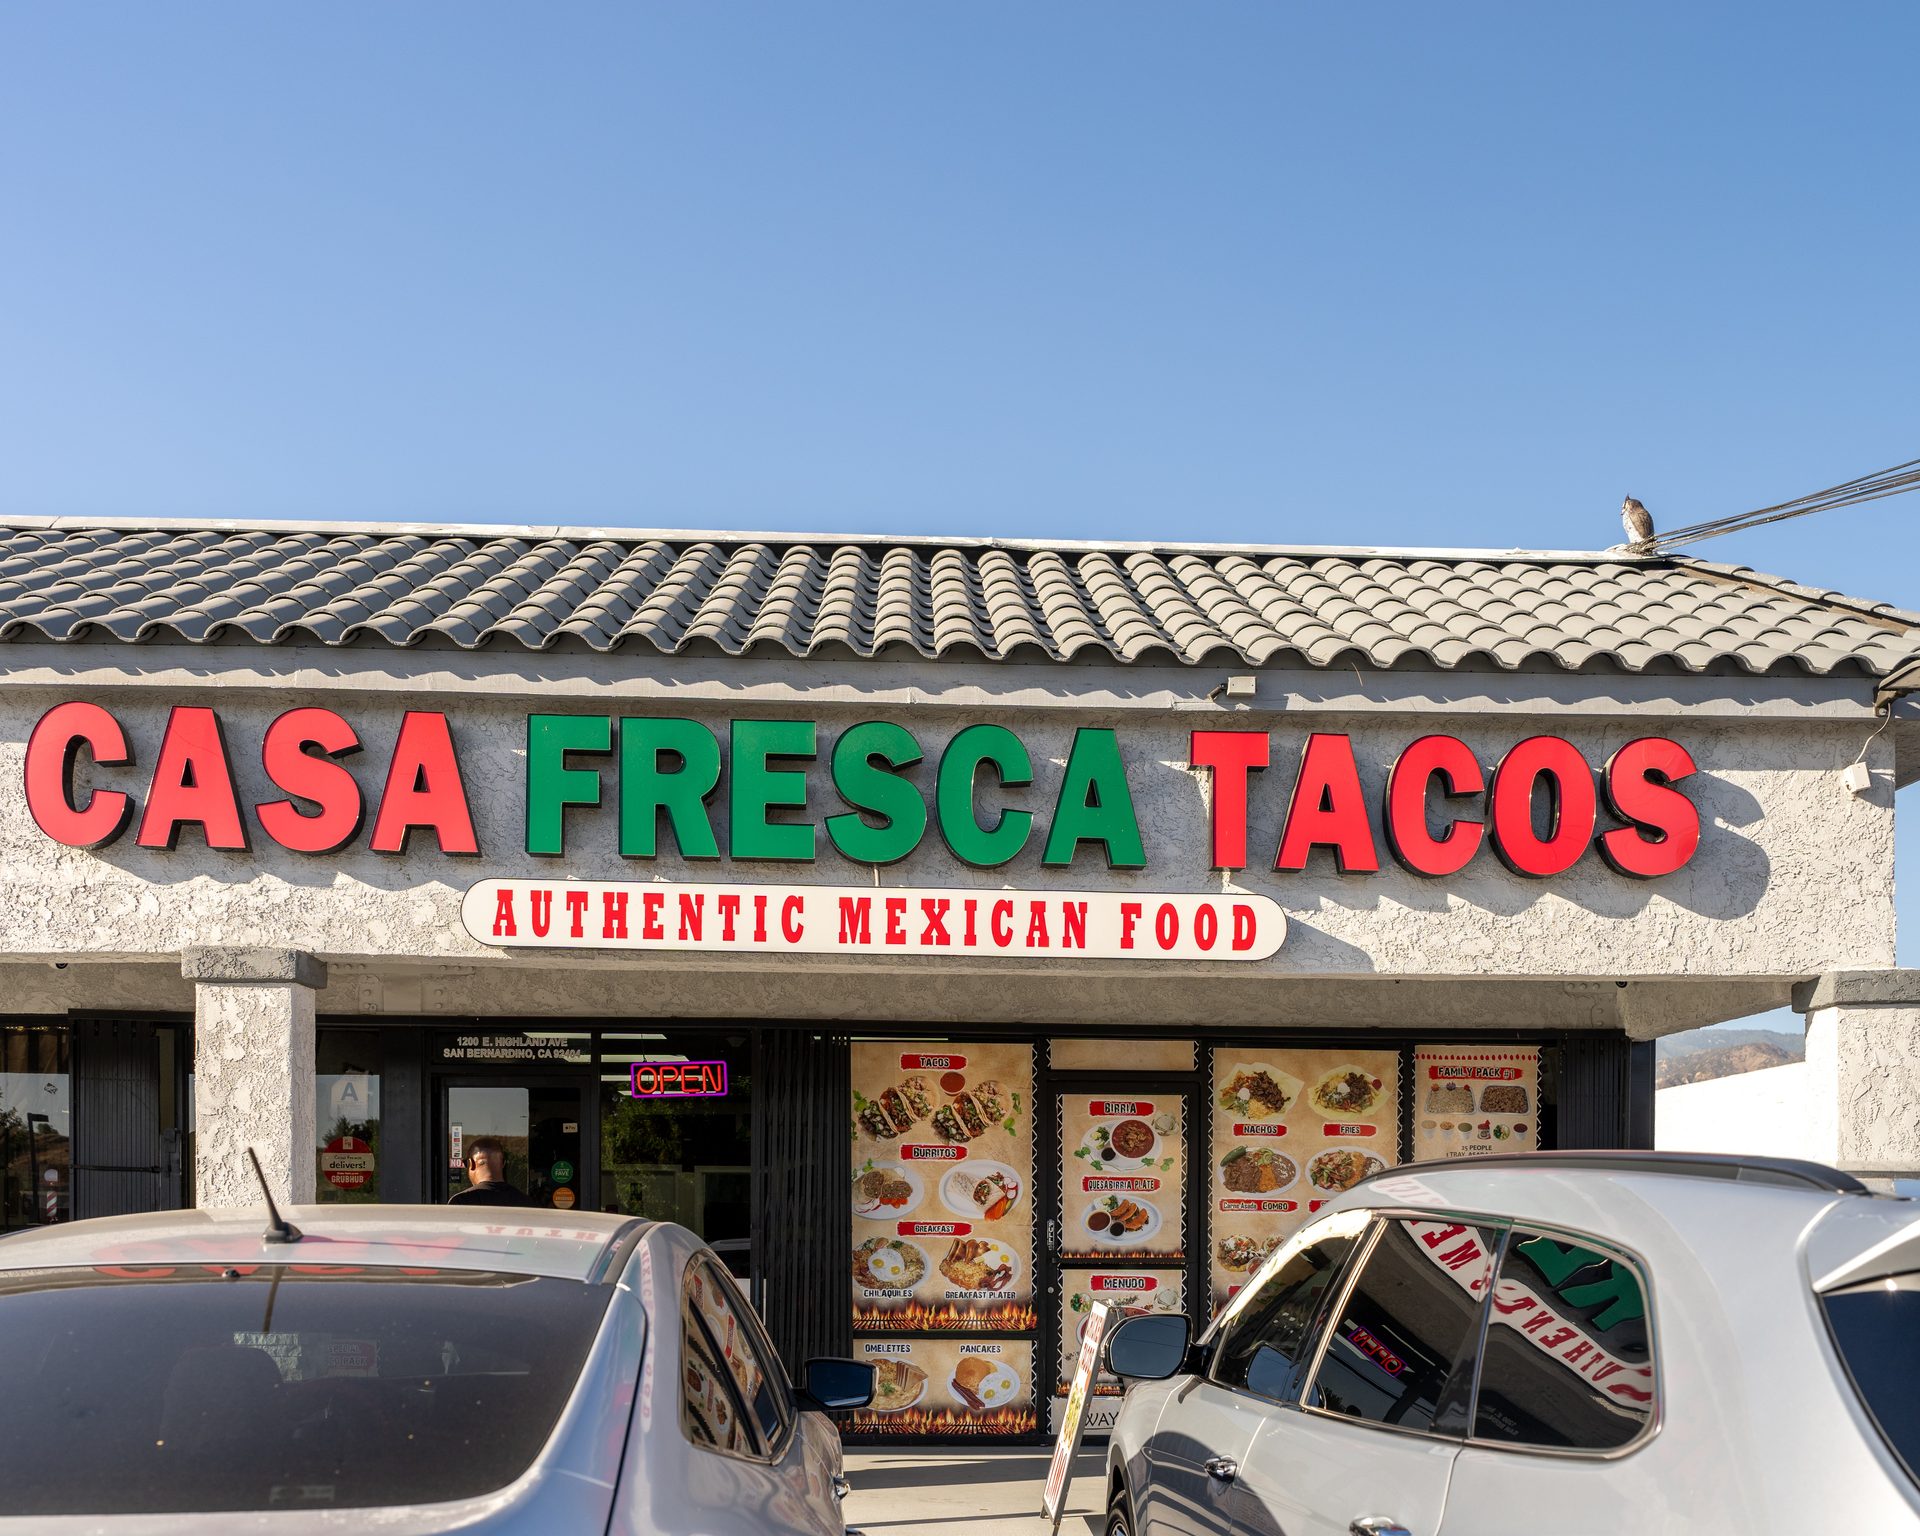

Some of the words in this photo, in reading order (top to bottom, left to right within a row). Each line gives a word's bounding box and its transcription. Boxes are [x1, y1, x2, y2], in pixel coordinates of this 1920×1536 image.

[24, 701, 481, 857] CASA
[525, 713, 1146, 870] FRESCA
[1187, 730, 1700, 878] TACOS
[492, 889, 804, 943] AUTHENTIC
[839, 897, 1088, 949] MEXICAN
[1121, 902, 1256, 951] FOOD
[457, 1037, 478, 1046] 1200
[482, 1037, 492, 1046] E.
[495, 1037, 547, 1047] HIGHLAND
[548, 1037, 568, 1047] AVE
[443, 1048, 464, 1058] SAN
[467, 1049, 535, 1060] BERNARDINO,
[537, 1049, 552, 1058] CA
[920, 1057, 949, 1067] TACOS
[1438, 1067, 1473, 1076] FAMILY
[1476, 1068, 1500, 1077] PACK
[1503, 1069, 1515, 1079] #1
[636, 1065, 721, 1094] OPEN
[341, 1082, 359, 1101] A
[1104, 1103, 1137, 1113] BIRRIA
[1244, 1125, 1278, 1134] NACHOS
[1340, 1126, 1360, 1134] FRIES
[913, 1147, 956, 1157] BURRITOS
[329, 1161, 366, 1169] delivers!
[331, 1175, 364, 1183] GRUBHUB
[1088, 1180, 1132, 1190] QUESABIRRIA
[1134, 1180, 1155, 1189] PLATE
[1262, 1202, 1288, 1210] COMBO
[915, 1225, 954, 1233] BREAKFAST
[1103, 1278, 1145, 1288] MENUDO
[863, 1289, 913, 1298] CHILAQUILES
[945, 1291, 987, 1299] BREAKFAST
[865, 1344, 911, 1353] OMELETTES
[960, 1345, 1001, 1354] PANCAKES
